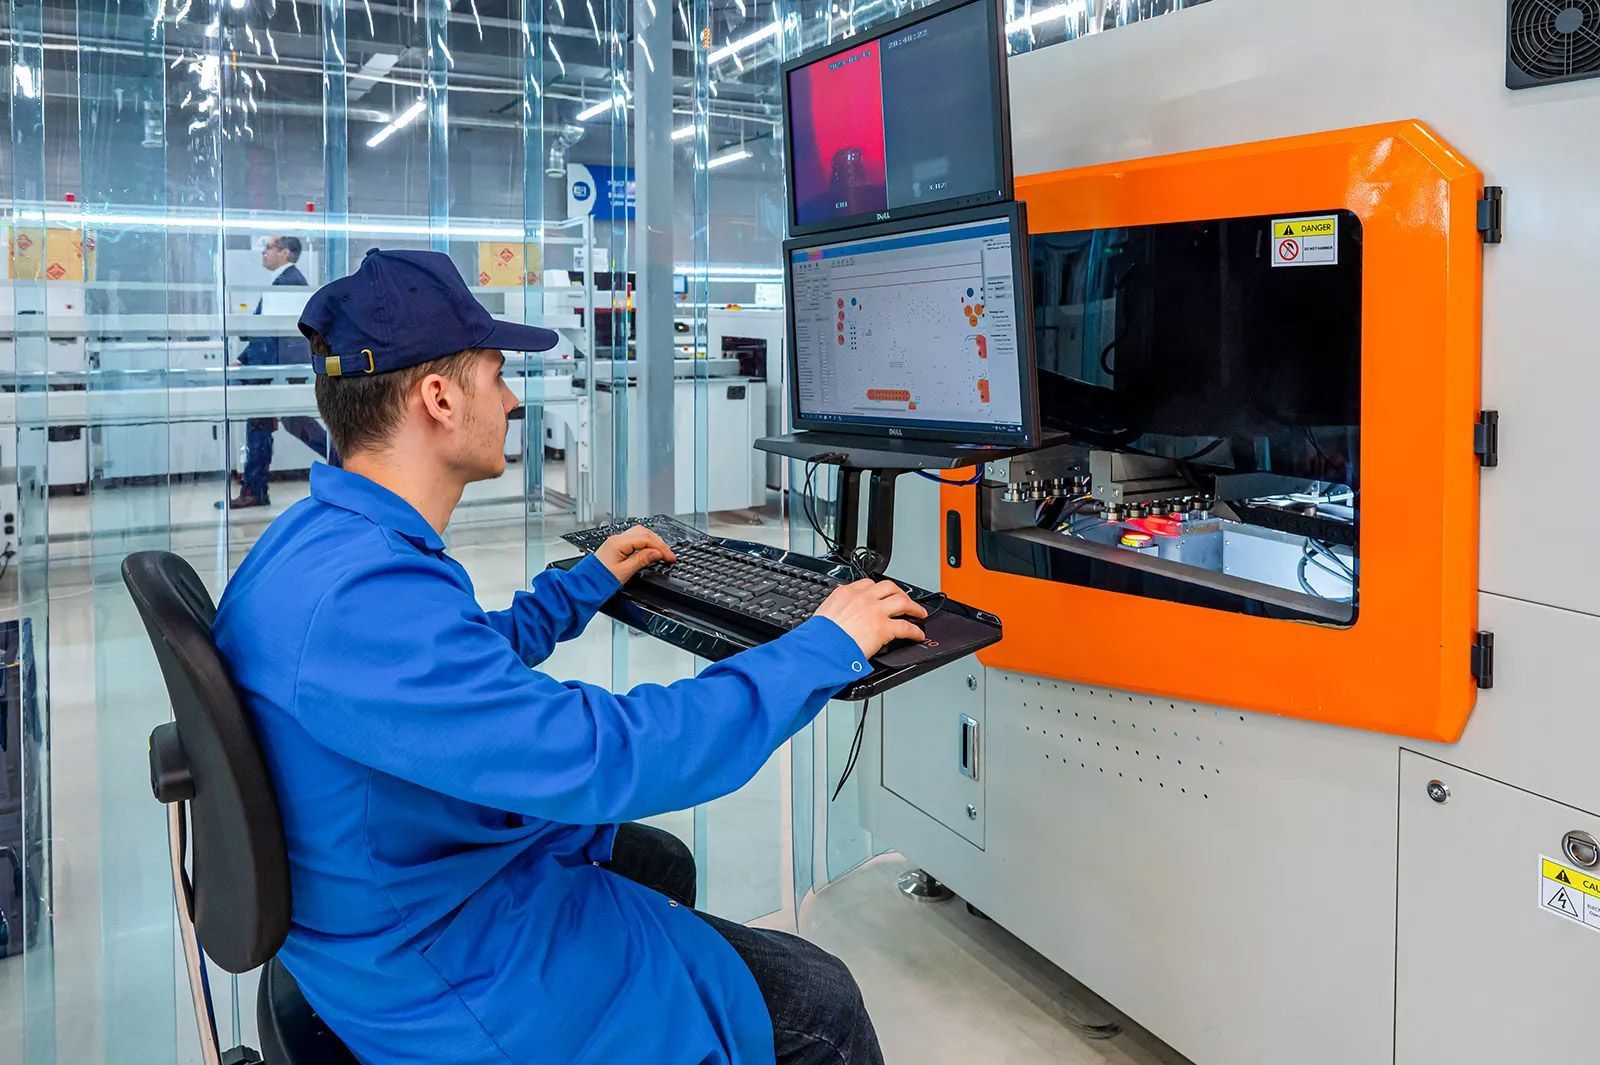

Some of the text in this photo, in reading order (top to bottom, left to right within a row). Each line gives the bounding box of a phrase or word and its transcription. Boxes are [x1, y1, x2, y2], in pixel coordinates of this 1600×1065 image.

[876, 212, 890, 220] DELL
[1301, 223, 1331, 232] DANGER
[889, 428, 903, 436] DELL
